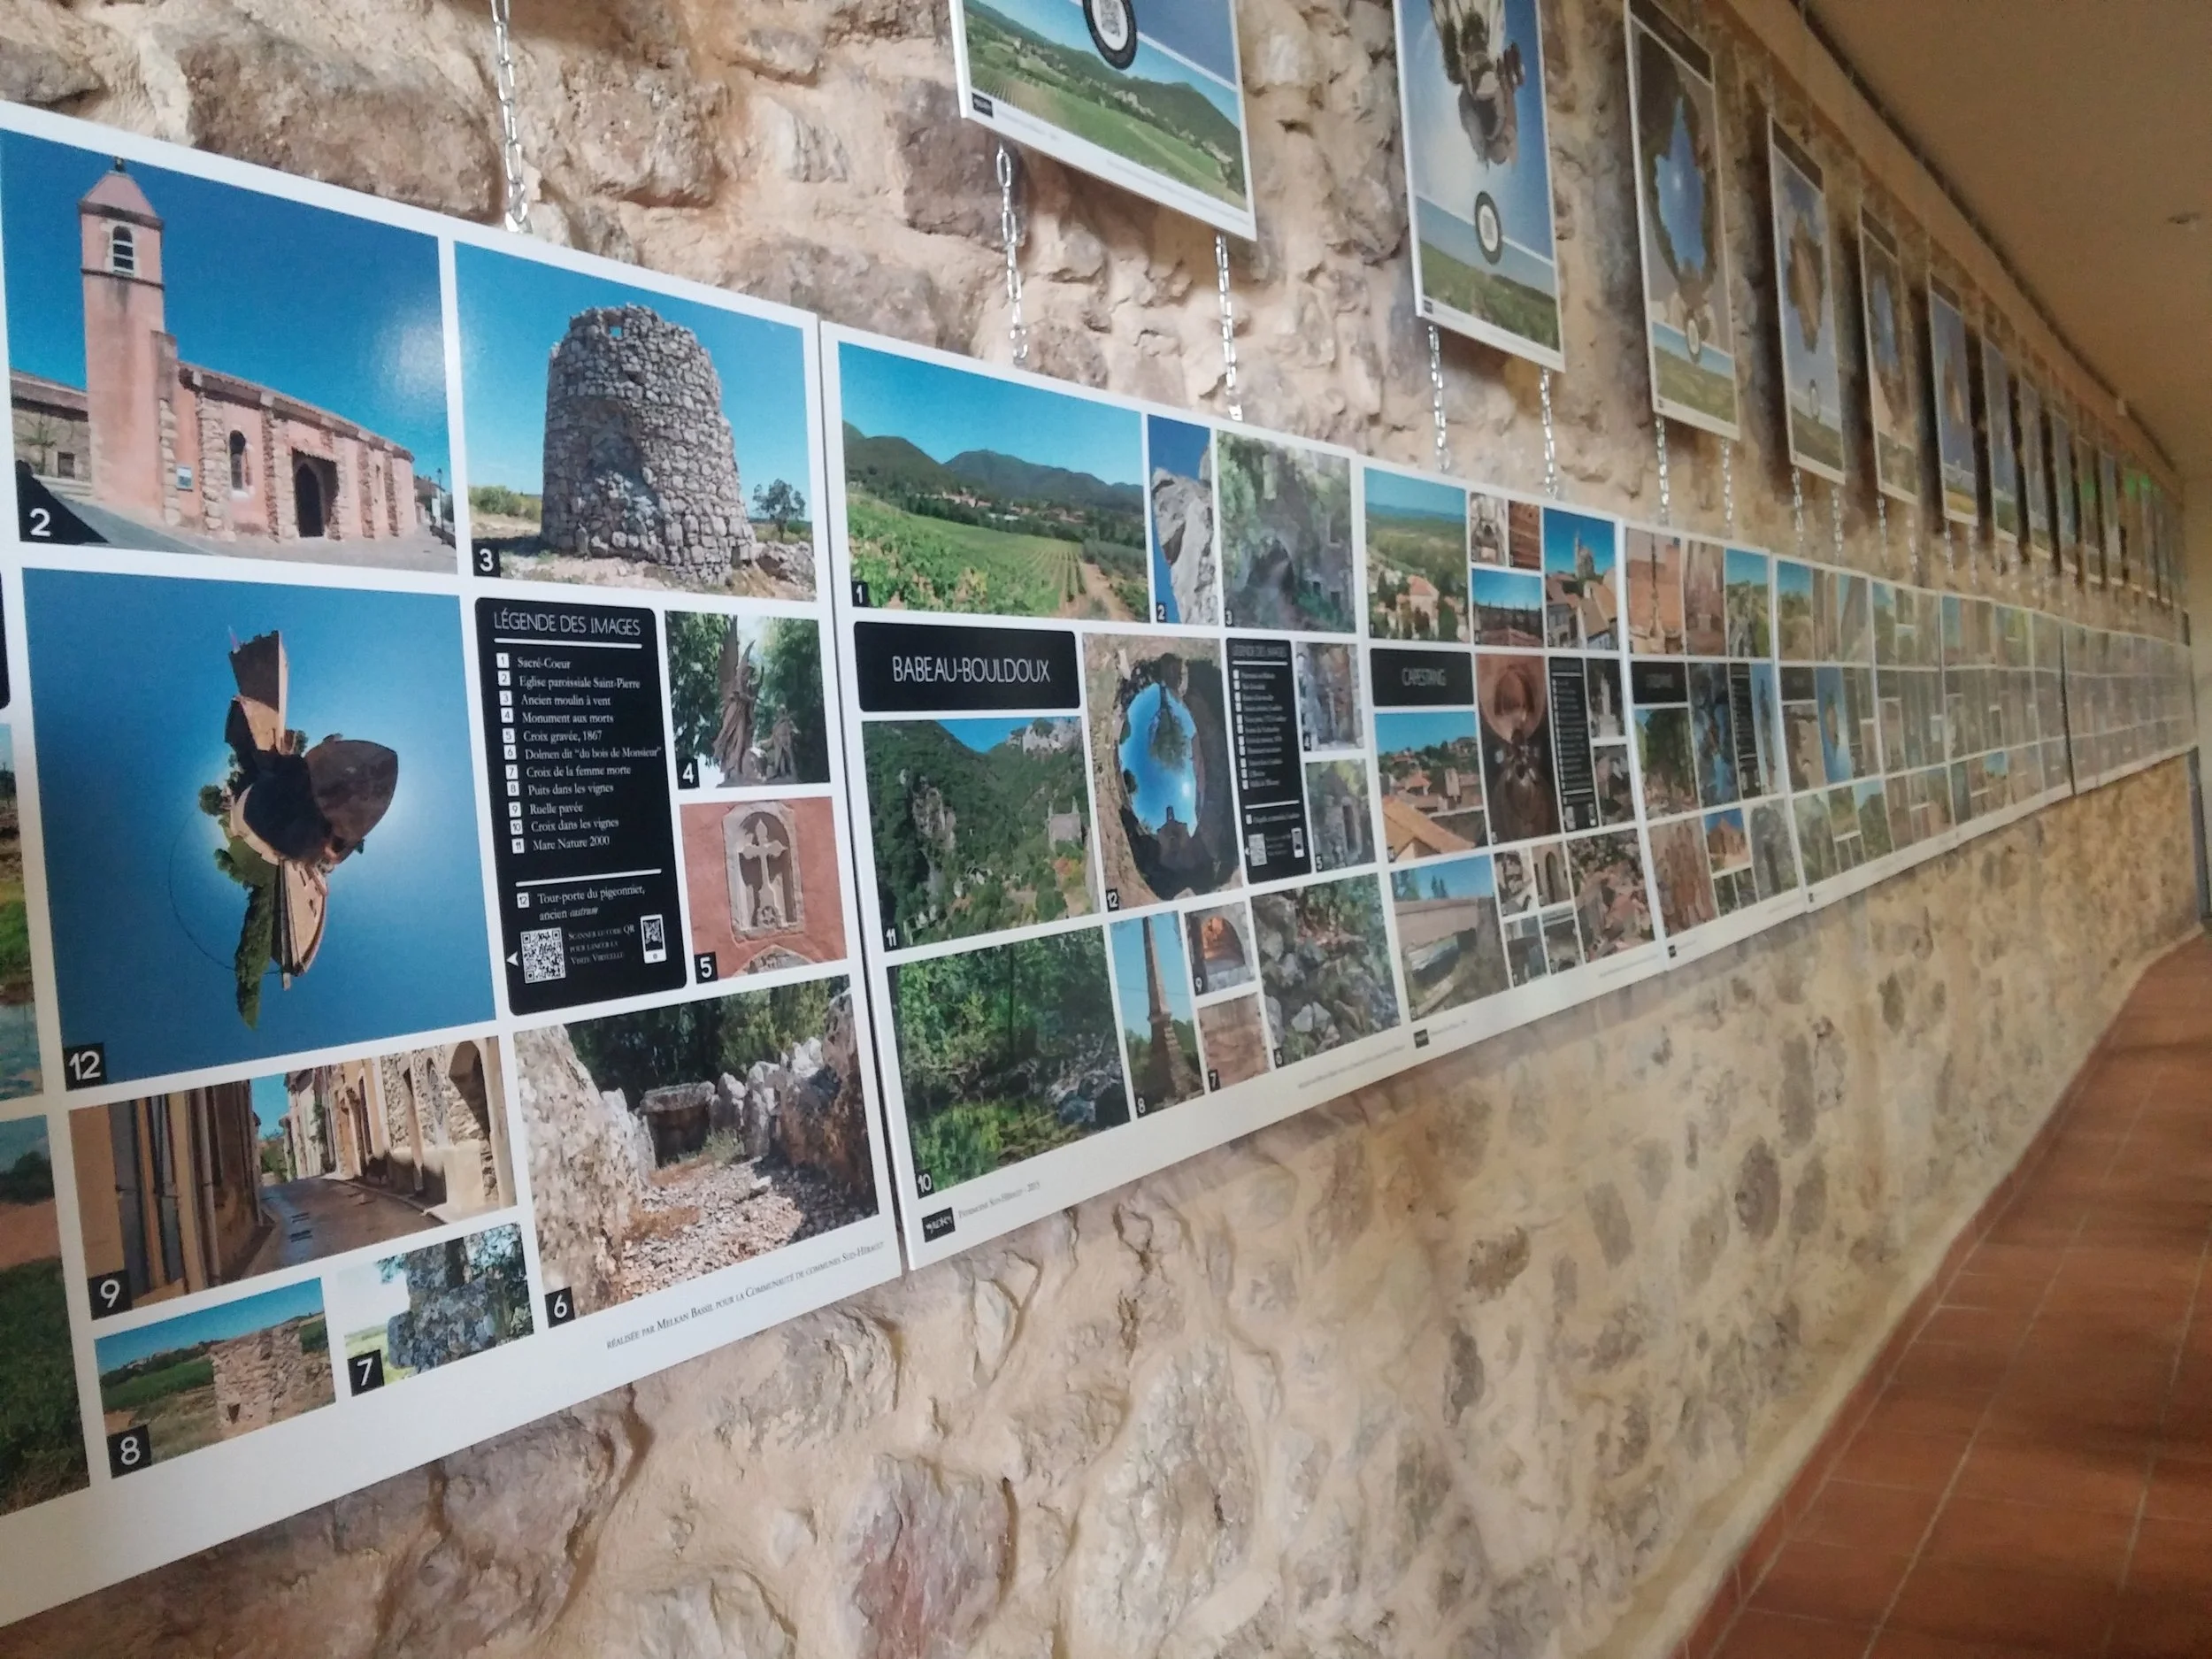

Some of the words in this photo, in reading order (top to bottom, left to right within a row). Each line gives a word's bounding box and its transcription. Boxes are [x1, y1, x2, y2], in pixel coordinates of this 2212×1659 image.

[30, 508, 52, 537] 2
[479, 548, 494, 572] 3
[856, 588, 863, 603] 1
[1157, 604, 1165, 620] 2
[494, 608, 557, 633] LÉGENDE
[560, 615, 587, 634] DES
[590, 618, 641, 636] IMAGES
[517, 656, 572, 670] Sacré-Coeur
[892, 656, 1051, 683] BABEAU-BOULDOUX
[501, 672, 508, 683] 2
[519, 676, 546, 691] Eglise
[548, 676, 591, 691] paroissiale
[593, 676, 641, 689] Saint-Pierre
[503, 693, 509, 703] 3
[521, 694, 552, 706] Ancien
[554, 694, 584, 706] moulin
[586, 694, 591, 705] à
[593, 695, 611, 706] vent
[504, 710, 511, 721] 4
[522, 711, 570, 724] Monument
[572, 714, 588, 724] aux
[589, 712, 614, 724] morts
[505, 730, 512, 741] 5
[523, 730, 549, 741] Croix
[550, 730, 580, 745] gravée,
[582, 730, 603, 741] 1867
[507, 747, 514, 757] 6
[525, 748, 560, 761] Dolmen
[562, 747, 572, 759] dit
[592, 747, 609, 758] bois
[610, 747, 620, 757] de
[508, 767, 515, 778] 7
[526, 766, 551, 779] Croix
[554, 765, 565, 777] de
[566, 764, 574, 777] la
[575, 764, 604, 777] femme
[606, 764, 631, 776] morte
[682, 763, 694, 784] 4
[510, 784, 517, 794] 8
[528, 784, 550, 796] Puits
[552, 784, 573, 795] dans
[575, 783, 586, 795] les
[588, 783, 614, 796] vignes
[511, 804, 518, 815] 9
[530, 803, 557, 815] Ruelle
[558, 802, 583, 816] pavée
[512, 823, 521, 832] 10
[531, 821, 557, 833] Croix
[557, 820, 578, 832] dans
[580, 819, 591, 831] les
[593, 818, 619, 833] vignes
[515, 841, 522, 850] 11
[533, 840, 557, 851] Mare
[557, 838, 588, 849] Nature
[589, 836, 610, 847] 2000
[518, 896, 527, 905] 12
[537, 890, 585, 906] Tour-porte
[587, 888, 598, 900] du
[600, 884, 646, 899] pigeonnier,
[1107, 892, 1118, 909] 12
[539, 910, 567, 922] ancien
[623, 924, 635, 935] QR
[886, 928, 897, 947] 11
[701, 957, 713, 979] 5
[1195, 977, 1203, 992] 9
[69, 1050, 102, 1081] 12
[1210, 1073, 1218, 1088] 7
[1137, 1096, 1146, 1113] 8
[918, 1173, 932, 1193] 10
[99, 1279, 120, 1308] 9
[606, 1331, 640, 1350] RÉALISÉE
[641, 1325, 656, 1338] PAR
[657, 1313, 689, 1332] MELKAN
[690, 1304, 714, 1319] BASSIL
[715, 1295, 734, 1310] POUR
[735, 1293, 745, 1304] LA
[745, 1273, 795, 1298] COMMUNAUTÉ
[795, 1269, 805, 1279] DE
[805, 1257, 841, 1276] COMMUNES
[841, 1240, 884, 1263] SUD-HÉRAULT
[553, 1294, 568, 1318] 6
[357, 1358, 373, 1386] 7
[119, 1434, 141, 1465] 8
